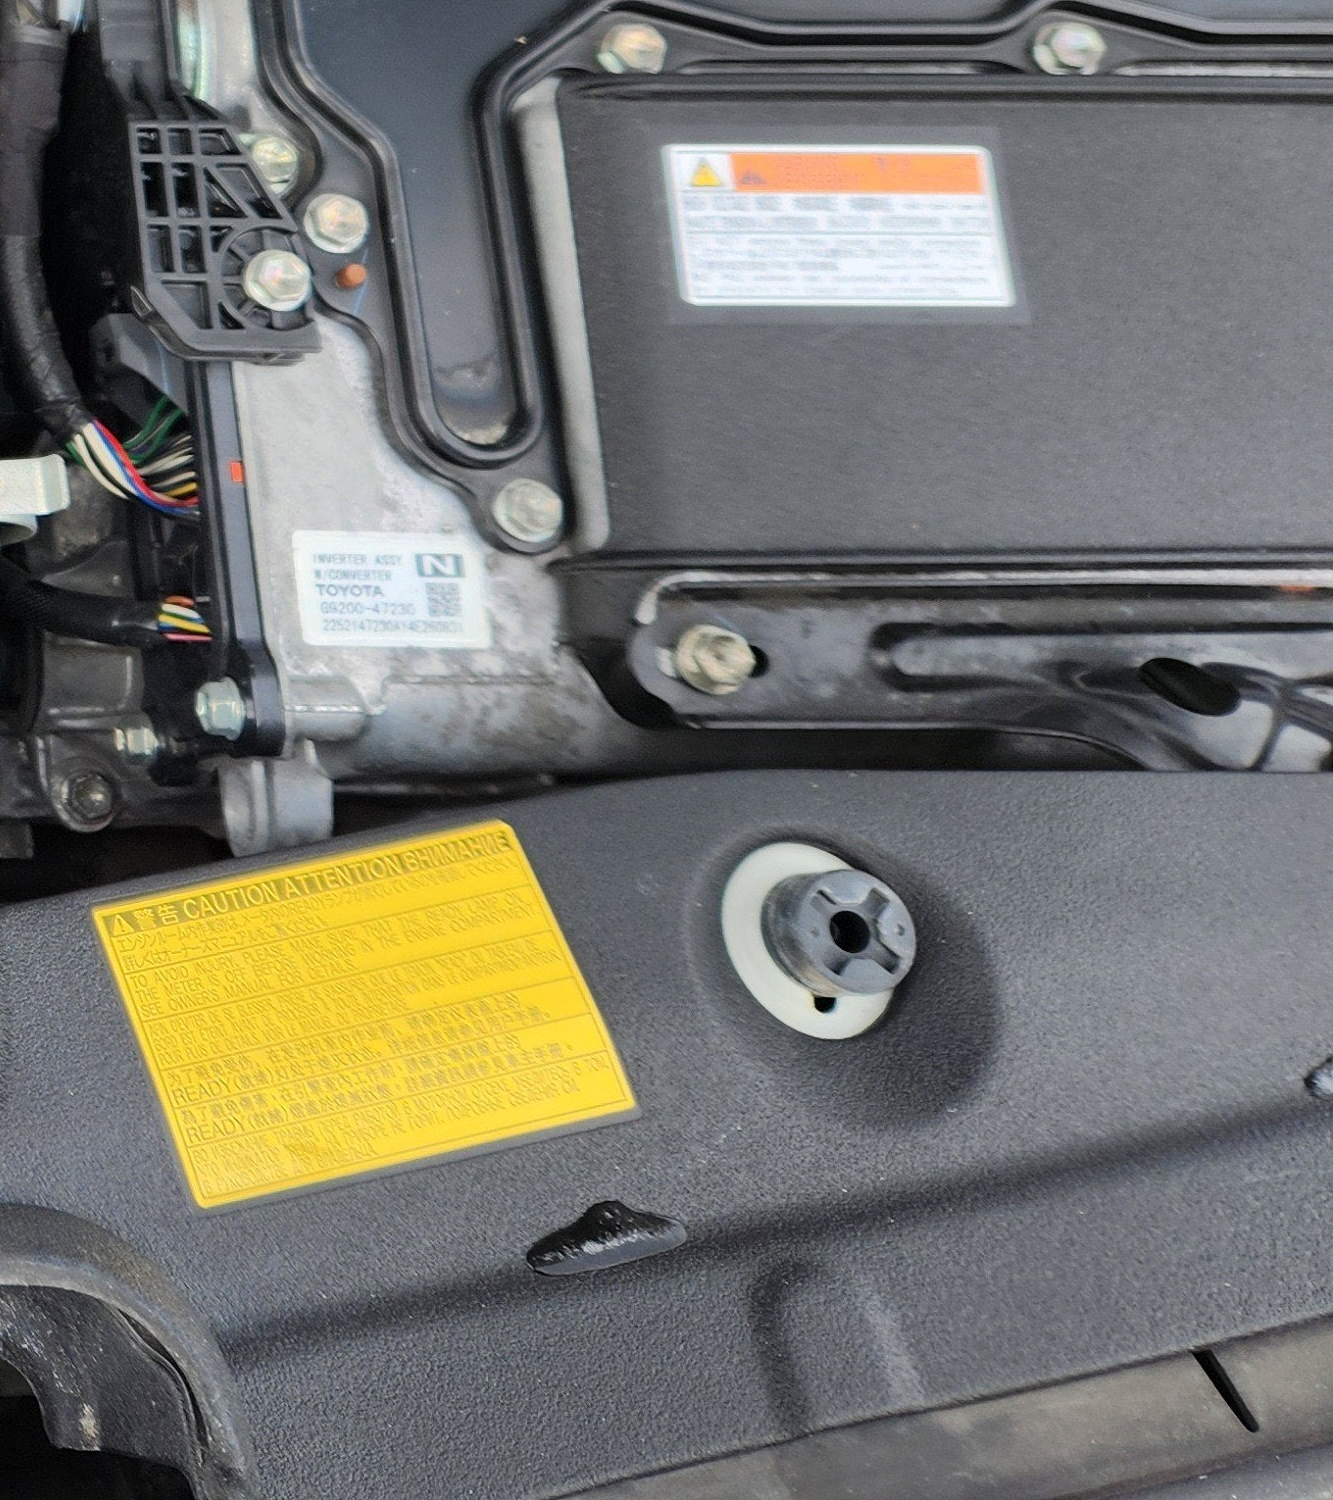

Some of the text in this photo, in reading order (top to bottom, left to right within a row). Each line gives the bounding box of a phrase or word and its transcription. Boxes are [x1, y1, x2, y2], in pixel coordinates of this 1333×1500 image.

[315, 583, 385, 597] TOYOTA
[179, 880, 280, 920] CAUTION
[279, 855, 403, 898] ATTENTION
[132, 901, 182, 931] 警告
[129, 973, 148, 989] TO
[152, 964, 190, 984] AVOID
[241, 944, 286, 965] PLEASE
[135, 986, 160, 1002] THE
[163, 976, 204, 996] METER
[206, 973, 221, 987] IS
[223, 967, 248, 983] OFF
[139, 1000, 164, 1018] SEE
[224, 977, 274, 999] MANUAL
[277, 970, 305, 988] FOR
